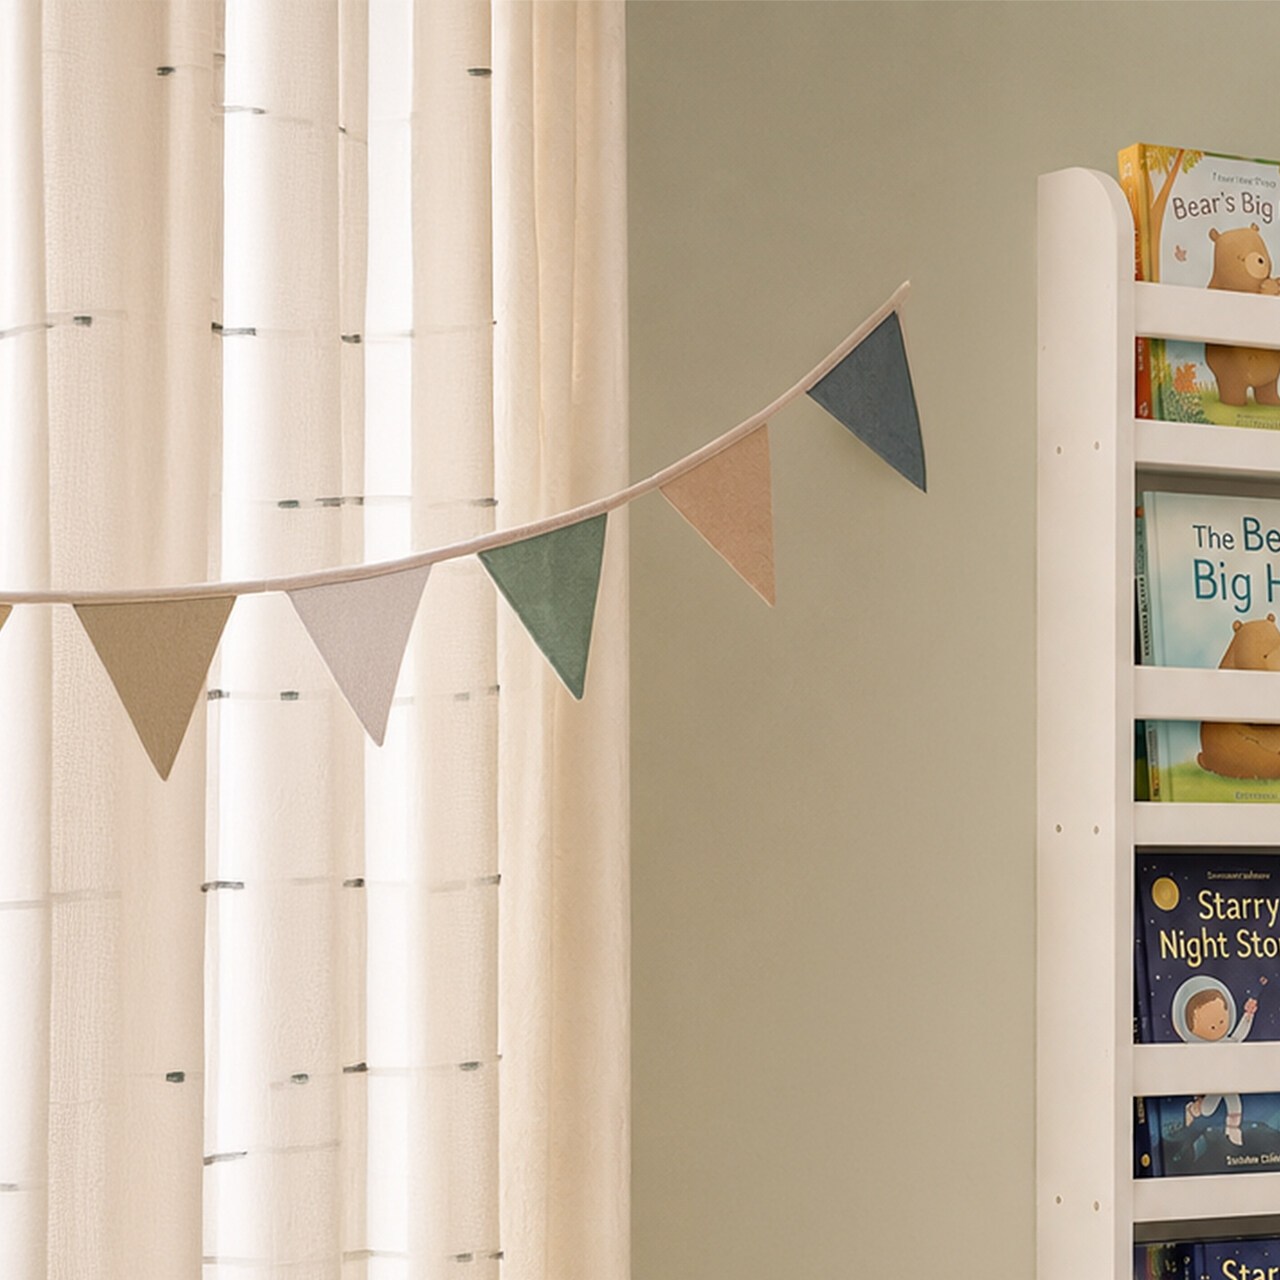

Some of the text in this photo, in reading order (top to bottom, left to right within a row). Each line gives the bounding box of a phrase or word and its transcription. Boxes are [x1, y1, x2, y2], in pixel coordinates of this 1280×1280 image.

[1172, 191, 1236, 220] Bear's
[1241, 191, 1273, 224] Big
[1192, 524, 1235, 550] The
[1193, 558, 1251, 613] Big
[1198, 889, 1280, 928] Starry
[1159, 927, 1230, 968] Night
